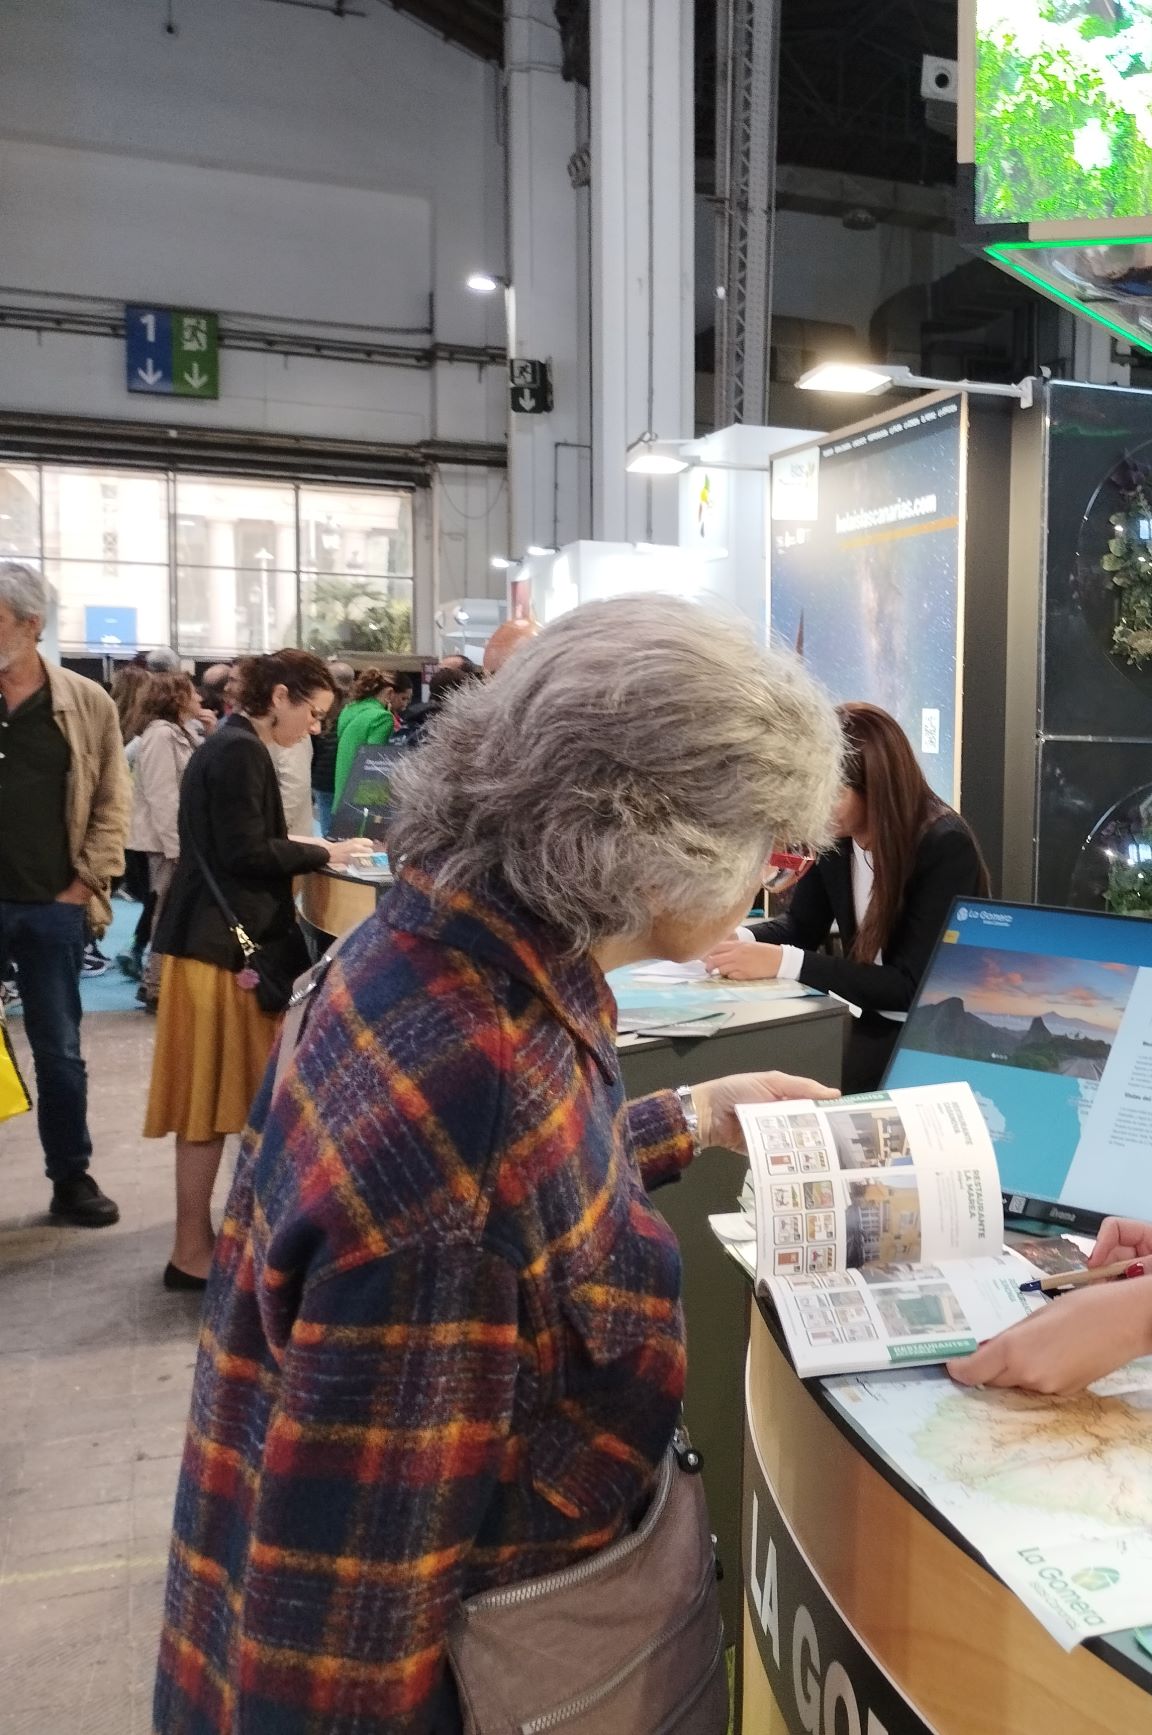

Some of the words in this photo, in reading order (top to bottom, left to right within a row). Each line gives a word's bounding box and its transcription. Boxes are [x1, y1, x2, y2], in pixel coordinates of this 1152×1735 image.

[140, 314, 155, 342] 1
[973, 1168, 986, 1240] RESTAURANTE
[751, 1489, 780, 1671] LA
[792, 1604, 889, 1735] GO
[1016, 1545, 1047, 1566] La
[1037, 1566, 1107, 1627] Gomera
